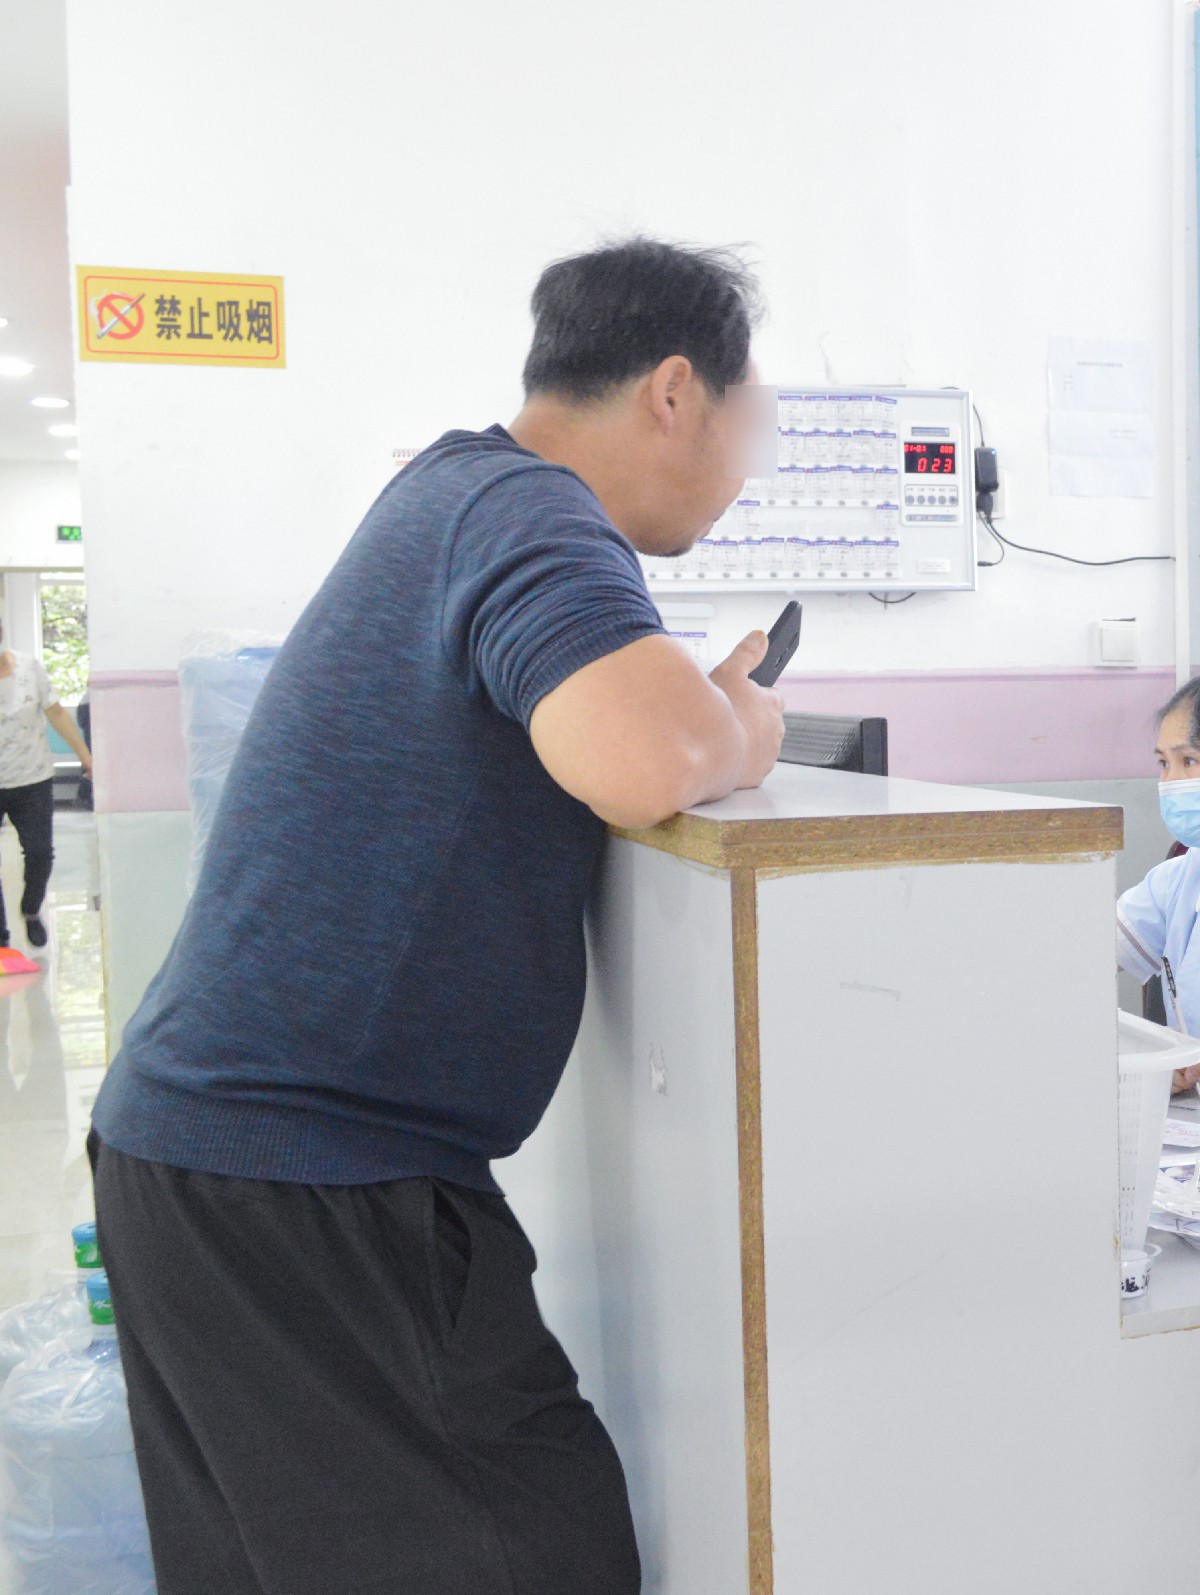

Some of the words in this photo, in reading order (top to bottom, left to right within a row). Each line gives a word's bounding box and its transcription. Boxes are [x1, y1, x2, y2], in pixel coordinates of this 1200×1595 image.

[155, 294, 273, 344] 禁止吸烟
[917, 457, 953, 473] 023
